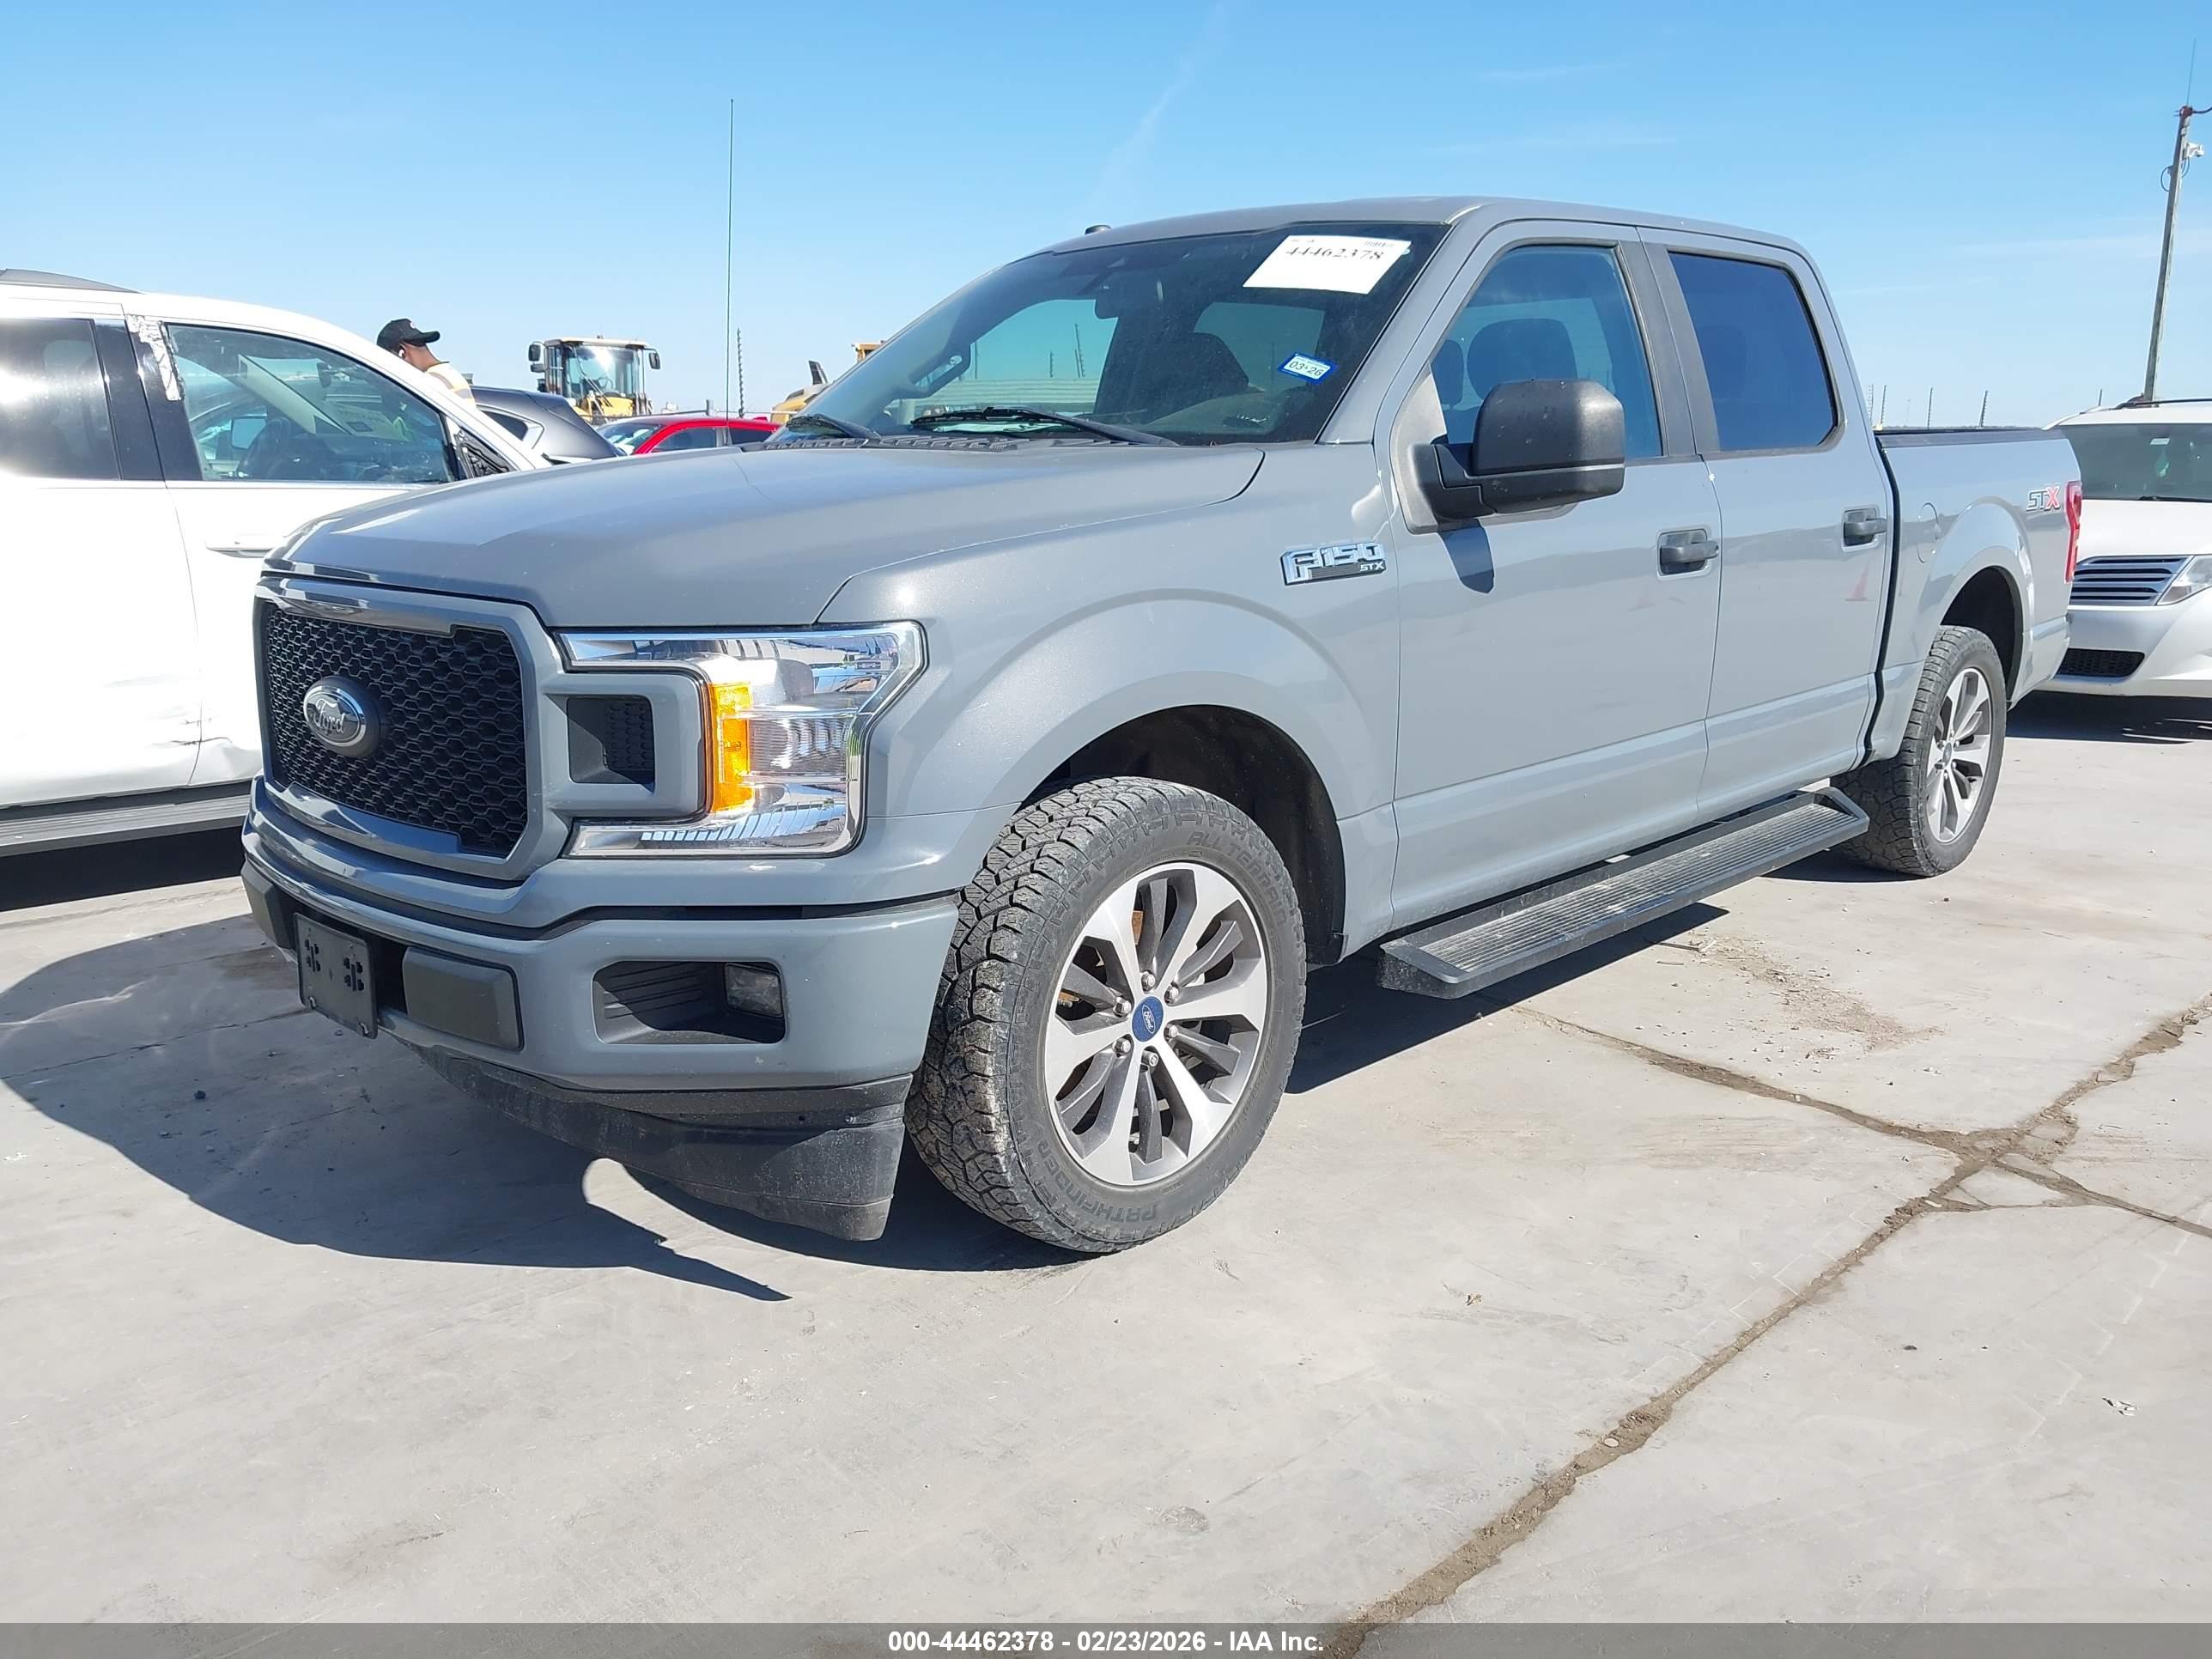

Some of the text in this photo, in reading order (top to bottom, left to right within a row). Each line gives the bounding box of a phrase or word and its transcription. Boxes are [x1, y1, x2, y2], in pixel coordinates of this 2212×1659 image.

[1285, 246, 1385, 260] 44462378
[2027, 485, 2062, 512] STX
[1279, 542, 1388, 586] F150
[1359, 562, 1385, 572] STX
[313, 697, 346, 734] Ford
[1186, 830, 1224, 851] ALL
